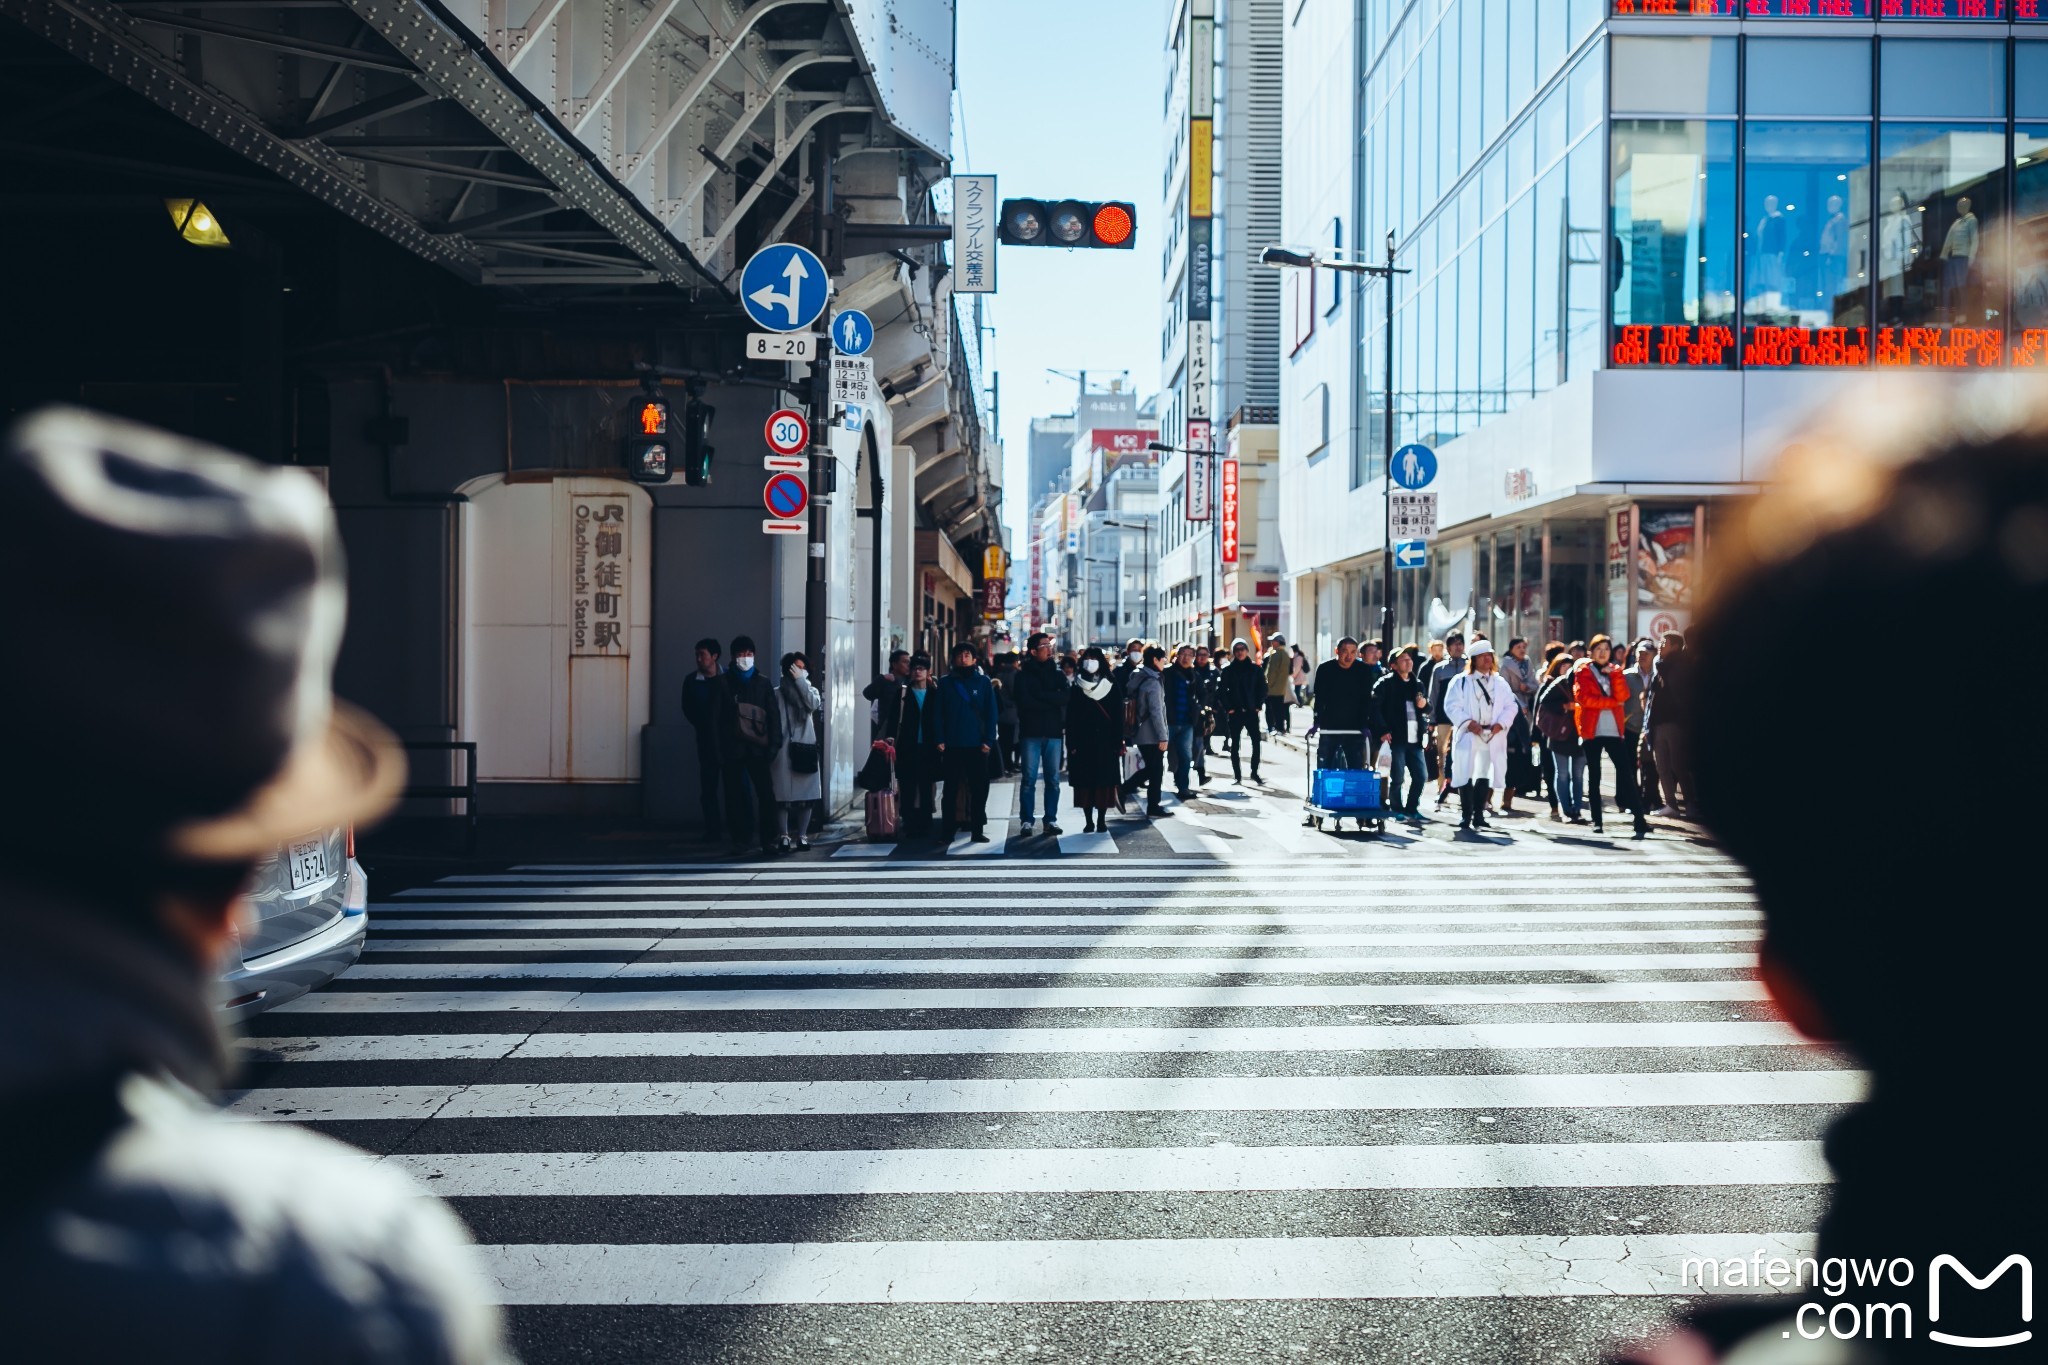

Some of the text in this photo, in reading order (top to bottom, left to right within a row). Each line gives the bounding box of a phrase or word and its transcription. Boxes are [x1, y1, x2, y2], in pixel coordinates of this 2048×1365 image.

[966, 180, 985, 287] スクランブル交差点
[1622, 325, 1652, 347] GET
[1661, 325, 1690, 346] THE
[1818, 326, 1848, 348] GET
[1902, 328, 1942, 348] NEW
[835, 359, 870, 369] 自転車を除く
[1657, 343, 1680, 365] TO
[1918, 346, 1968, 367] STORE
[776, 422, 799, 442] 30
[574, 504, 590, 648] Okachimachi Station
[593, 504, 624, 648] JR御徒町駅
[300, 853, 325, 882] 15-24
